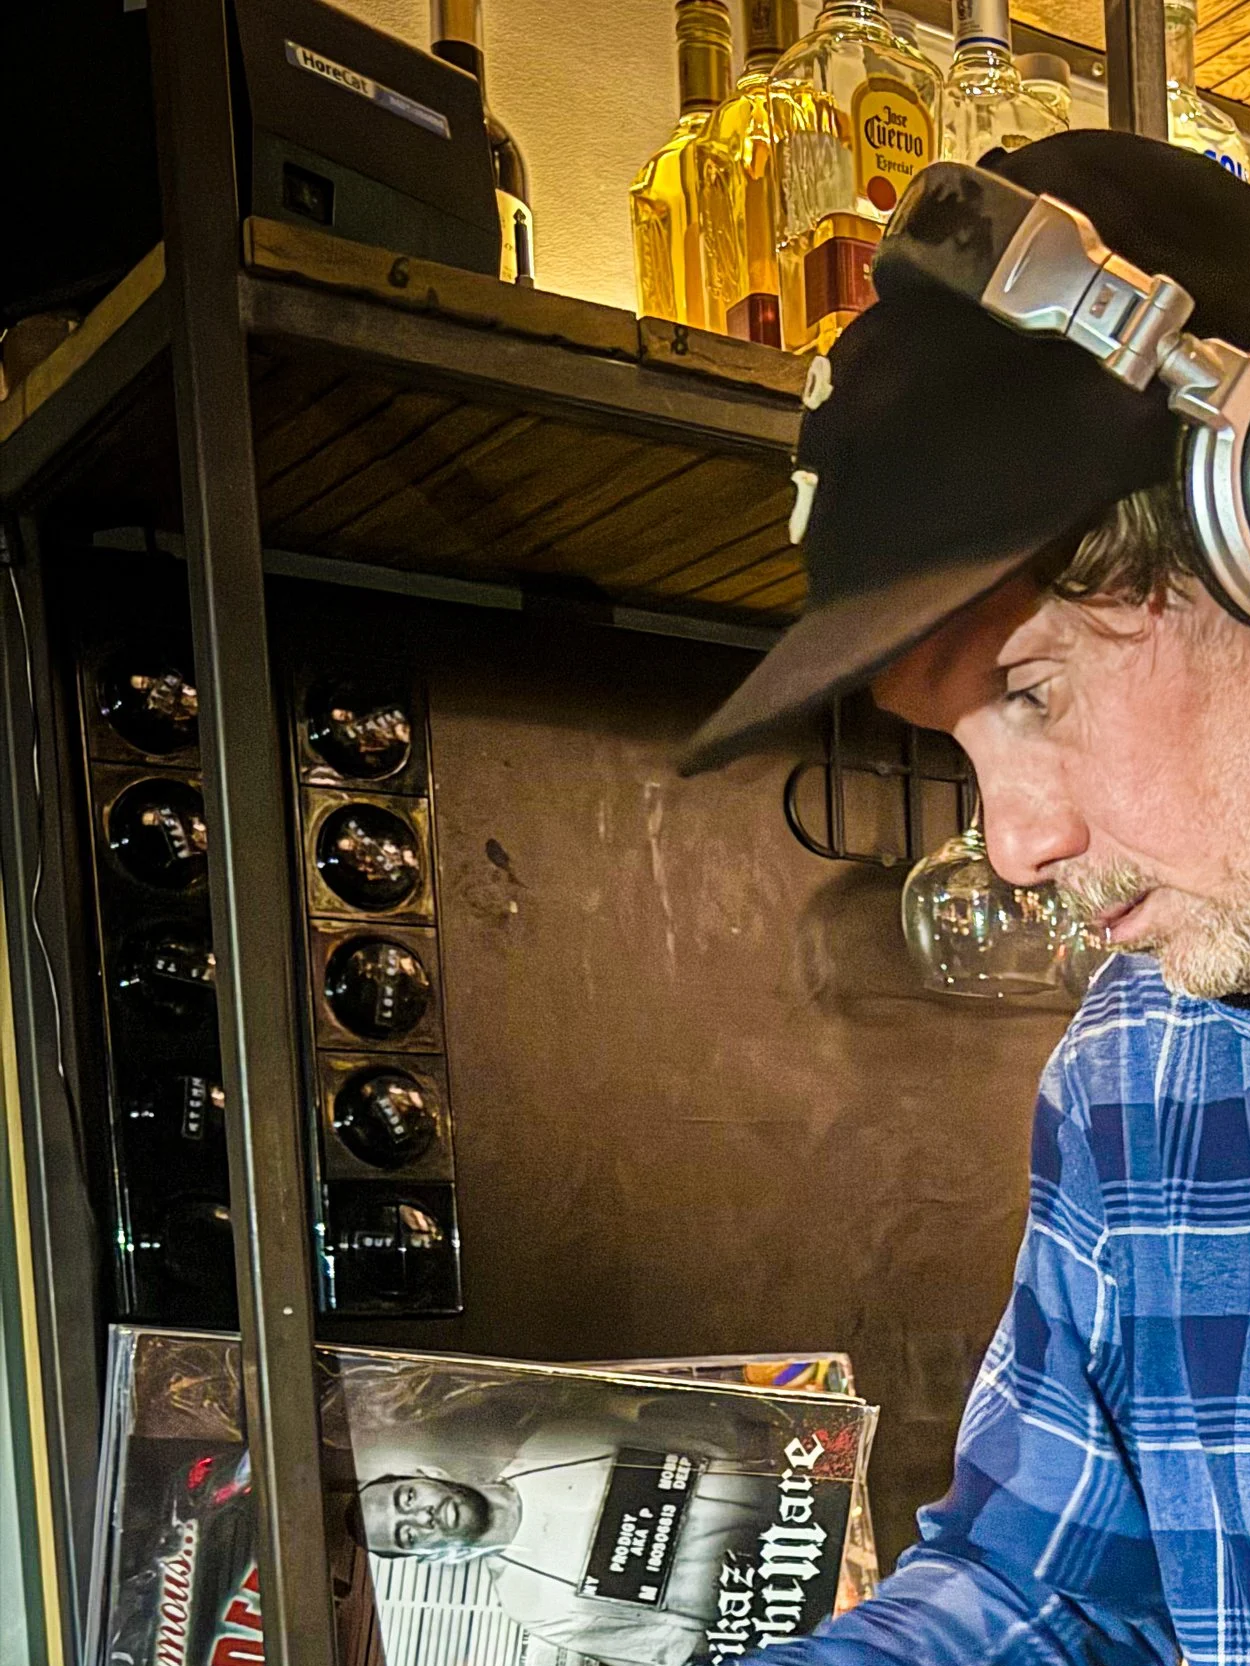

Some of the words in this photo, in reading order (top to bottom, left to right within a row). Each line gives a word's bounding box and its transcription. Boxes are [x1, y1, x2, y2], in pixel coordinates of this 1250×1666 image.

[883, 105, 908, 128] Jose
[864, 114, 923, 157] Cuervo
[875, 152, 914, 176] Especial
